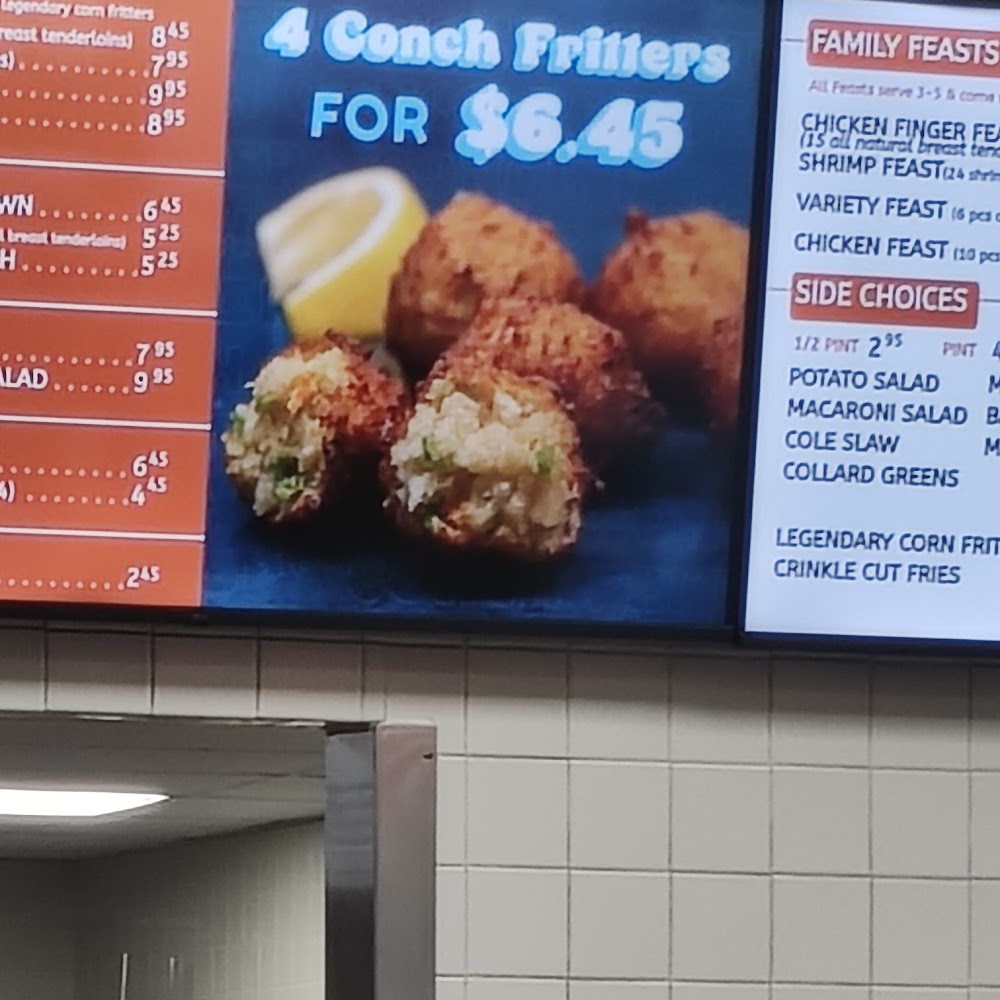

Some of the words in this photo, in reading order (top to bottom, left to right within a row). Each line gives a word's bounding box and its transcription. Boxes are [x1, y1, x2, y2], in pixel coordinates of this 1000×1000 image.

[107, 4, 154, 21] fritters
[264, 6, 310, 58] 4
[324, 9, 501, 70] Conch
[513, 21, 732, 83] Fritters
[811, 28, 902, 59] FAMILY
[907, 34, 1000, 66] FEASTS
[310, 91, 430, 145] FOR
[454, 82, 685, 170] $6.45
[801, 113, 888, 136] CHICKEN
[894, 118, 966, 140] FINGER
[973, 122, 1000, 142] FE
[830, 133, 850, 149] all
[855, 138, 912, 153] natural
[918, 141, 966, 157] breast
[799, 152, 876, 174] SHRIMP
[883, 157, 945, 179] FEAST
[797, 192, 880, 216] VARIETY
[885, 197, 948, 219] FEAST
[794, 232, 880, 257] CHICKEN
[887, 237, 949, 260] FEAST
[795, 279, 853, 307] SIDE
[859, 282, 969, 313] CHOICES
[825, 337, 860, 353] PINT
[943, 342, 977, 358] PINT
[789, 367, 868, 390] POTATO
[873, 371, 940, 393] SALAD
[787, 398, 896, 422] MACARONI
[901, 404, 968, 424] SALAD
[785, 430, 837, 450] COLE
[842, 433, 900, 453] SLAW
[783, 461, 875, 484] COLLARD
[881, 466, 960, 488] GREENS
[776, 528, 894, 550] LEGENDARY
[900, 533, 955, 553] CORN
[774, 559, 857, 581] CRINKLE
[862, 562, 902, 582] CUT
[907, 564, 961, 585] FRIES
